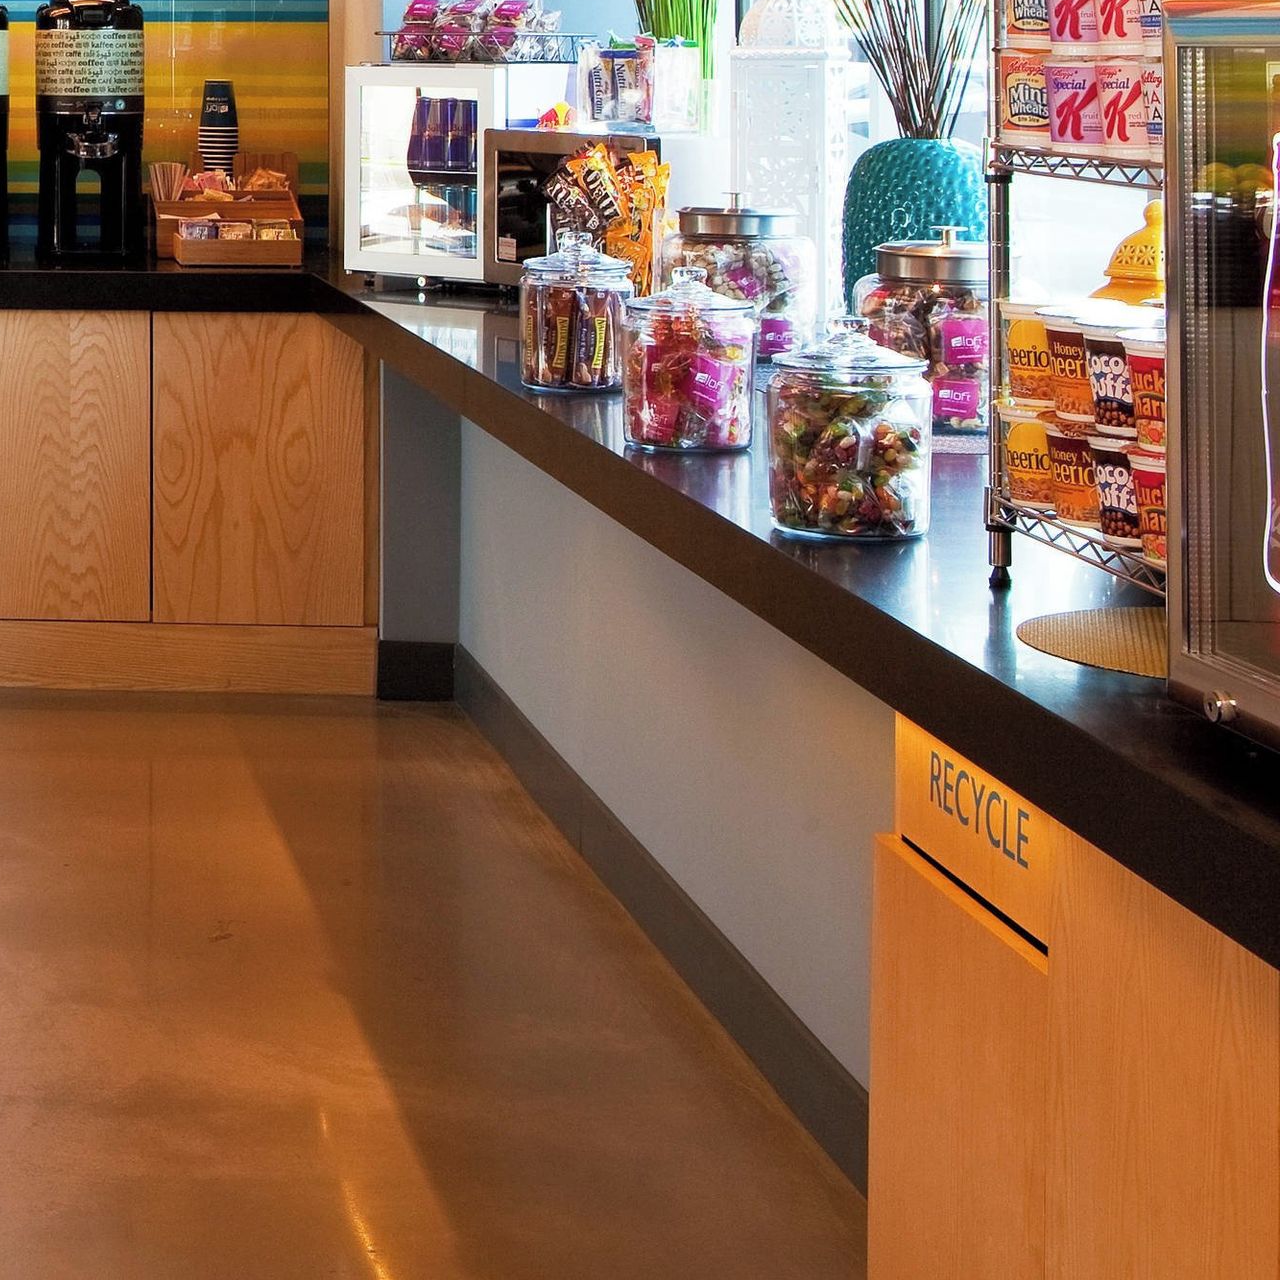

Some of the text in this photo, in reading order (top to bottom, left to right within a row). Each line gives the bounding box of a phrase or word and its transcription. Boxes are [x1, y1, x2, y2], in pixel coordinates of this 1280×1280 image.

[1056, 81, 1098, 141] K
[1104, 80, 1142, 142] K
[930, 750, 1030, 870] RECYCLE
